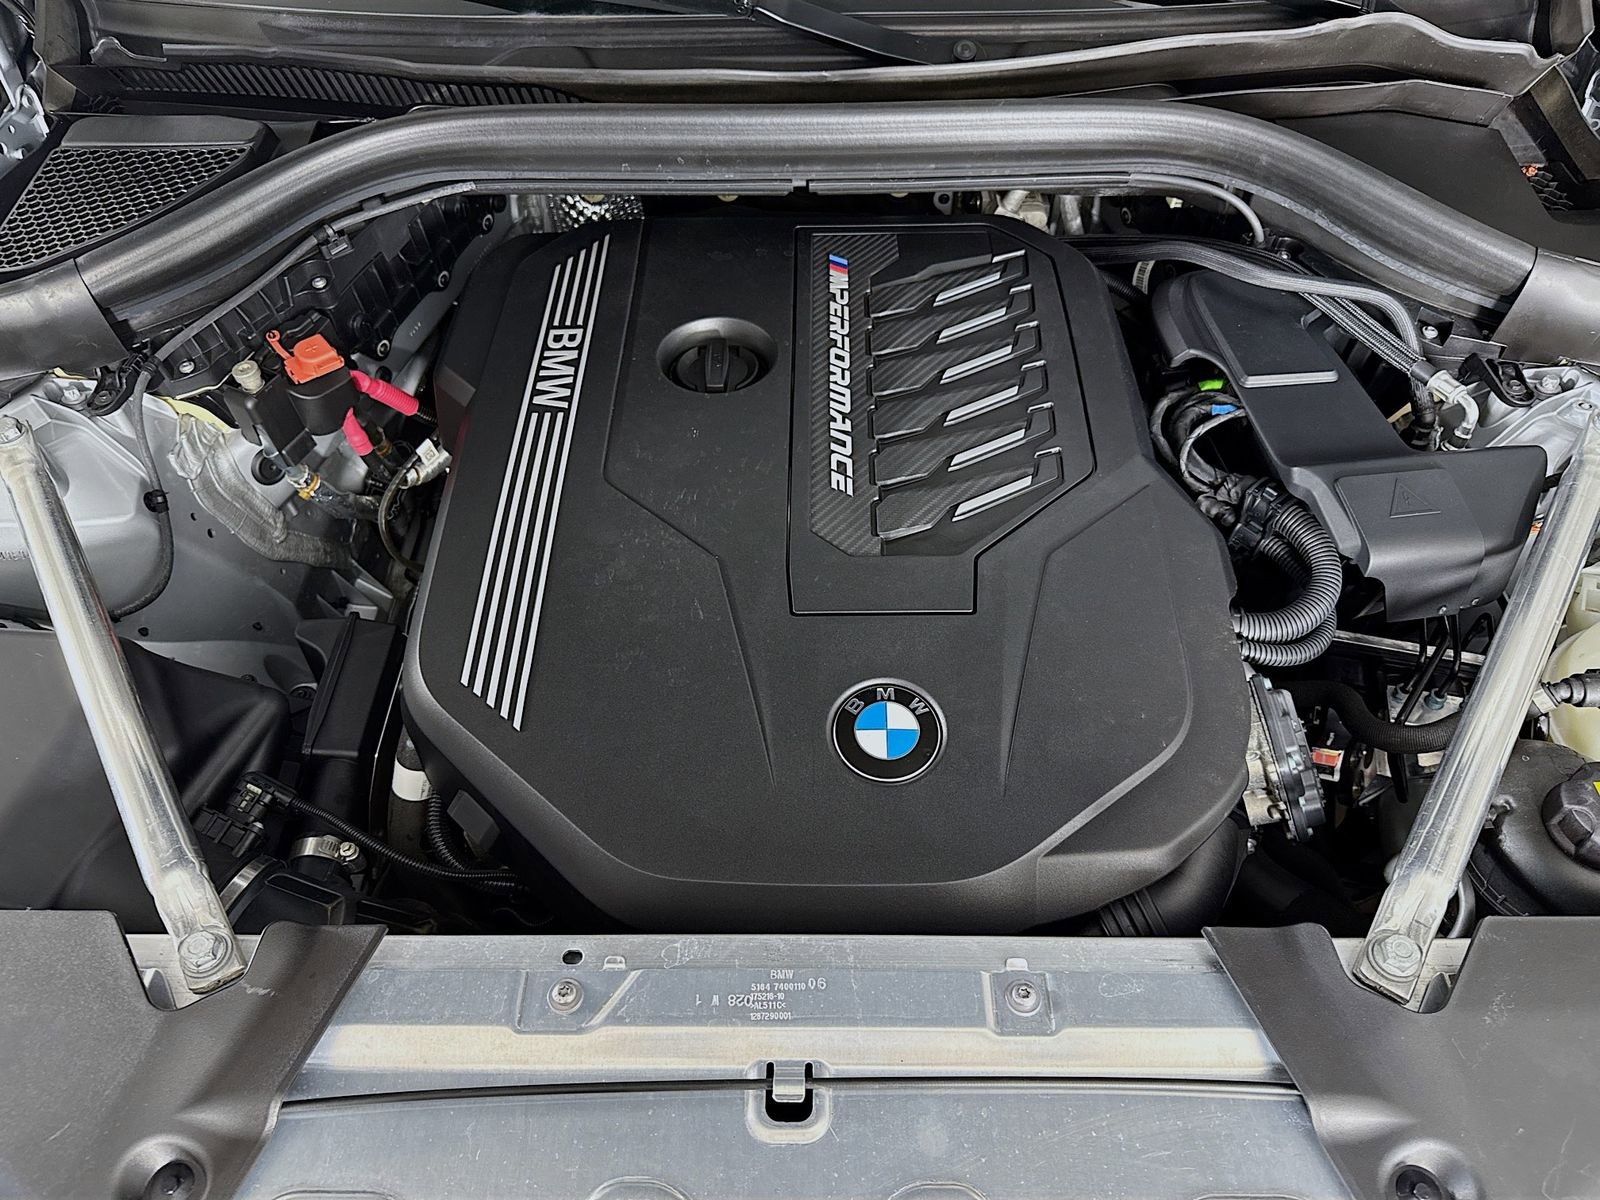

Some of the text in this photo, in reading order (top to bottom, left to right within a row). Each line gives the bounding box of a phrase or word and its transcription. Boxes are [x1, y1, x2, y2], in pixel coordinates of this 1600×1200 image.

[532, 328, 584, 409] BMW
[843, 687, 931, 717] BMW
[770, 969, 794, 980] BMW
[807, 977, 827, 990] 06
